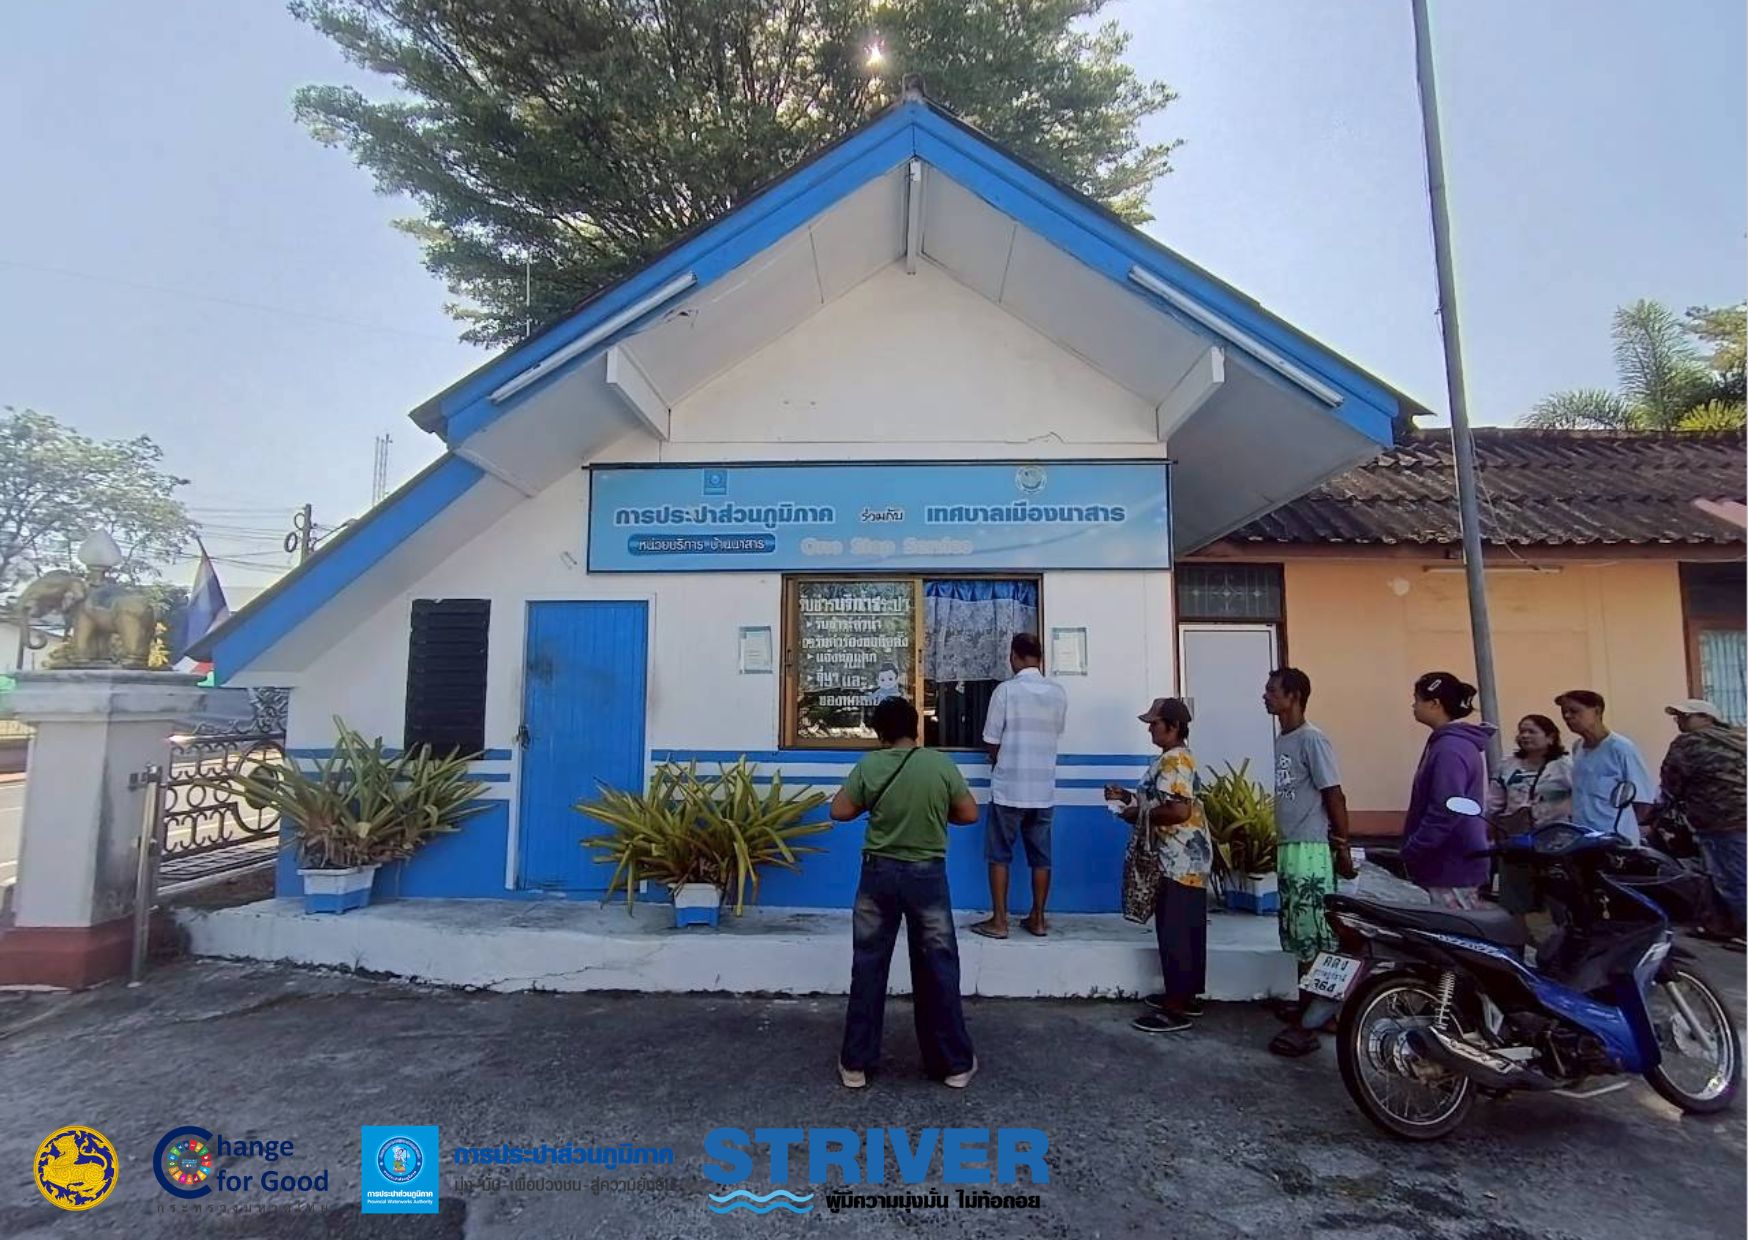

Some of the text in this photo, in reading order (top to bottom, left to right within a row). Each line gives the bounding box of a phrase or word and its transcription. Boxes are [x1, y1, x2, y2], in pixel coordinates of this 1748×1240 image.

[615, 501, 1126, 529] การประปาส่วนภูมิภาค ร่วมกับ เทศบาลเมืองนาสาร
[638, 537, 703, 552] หน่วยบริการ
